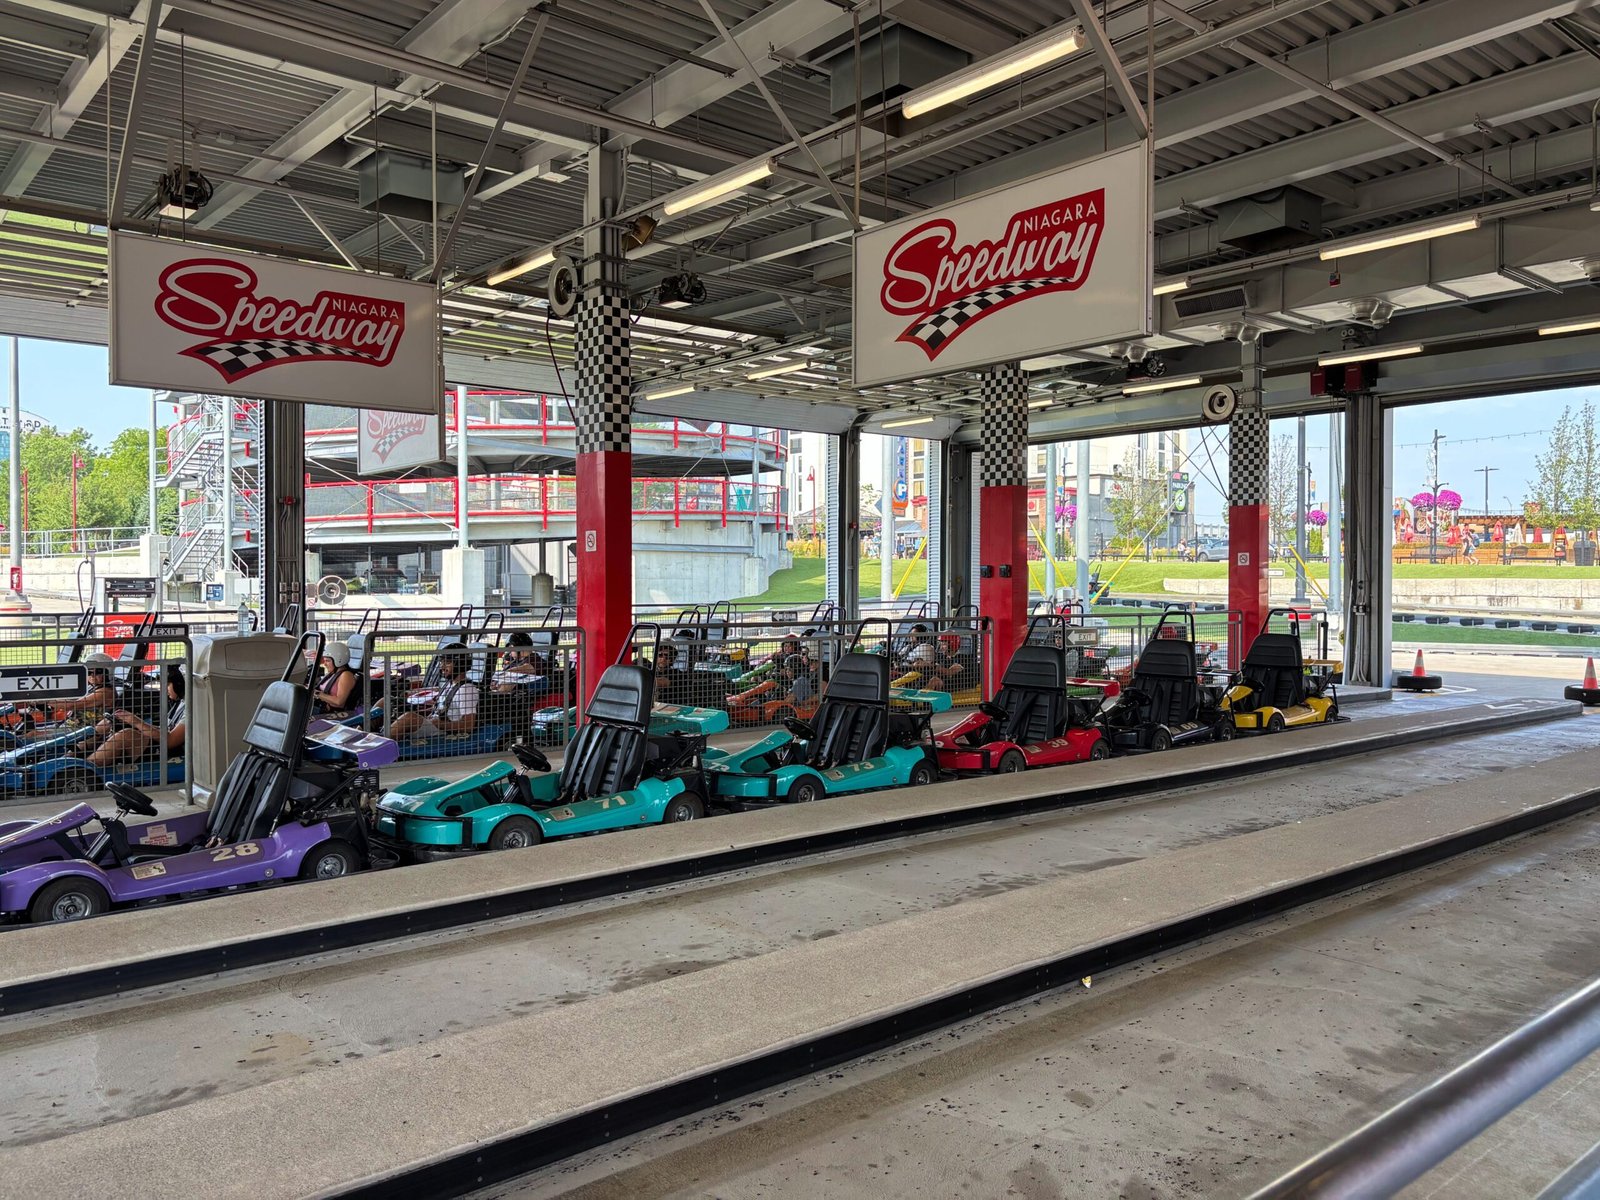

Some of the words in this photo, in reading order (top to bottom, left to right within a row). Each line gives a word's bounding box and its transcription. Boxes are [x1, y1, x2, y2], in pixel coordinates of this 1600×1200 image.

[1023, 200, 1098, 234] NIAGARA
[884, 220, 1098, 309] Speedway
[161, 264, 399, 362] Speedway
[332, 298, 400, 320] NIAGARA
[1078, 633, 1092, 641] EXIT
[17, 676, 63, 691] EXIT
[1047, 738, 1069, 748] 39
[846, 761, 875, 772] 73
[594, 795, 627, 809] 71
[209, 842, 260, 862] 28
